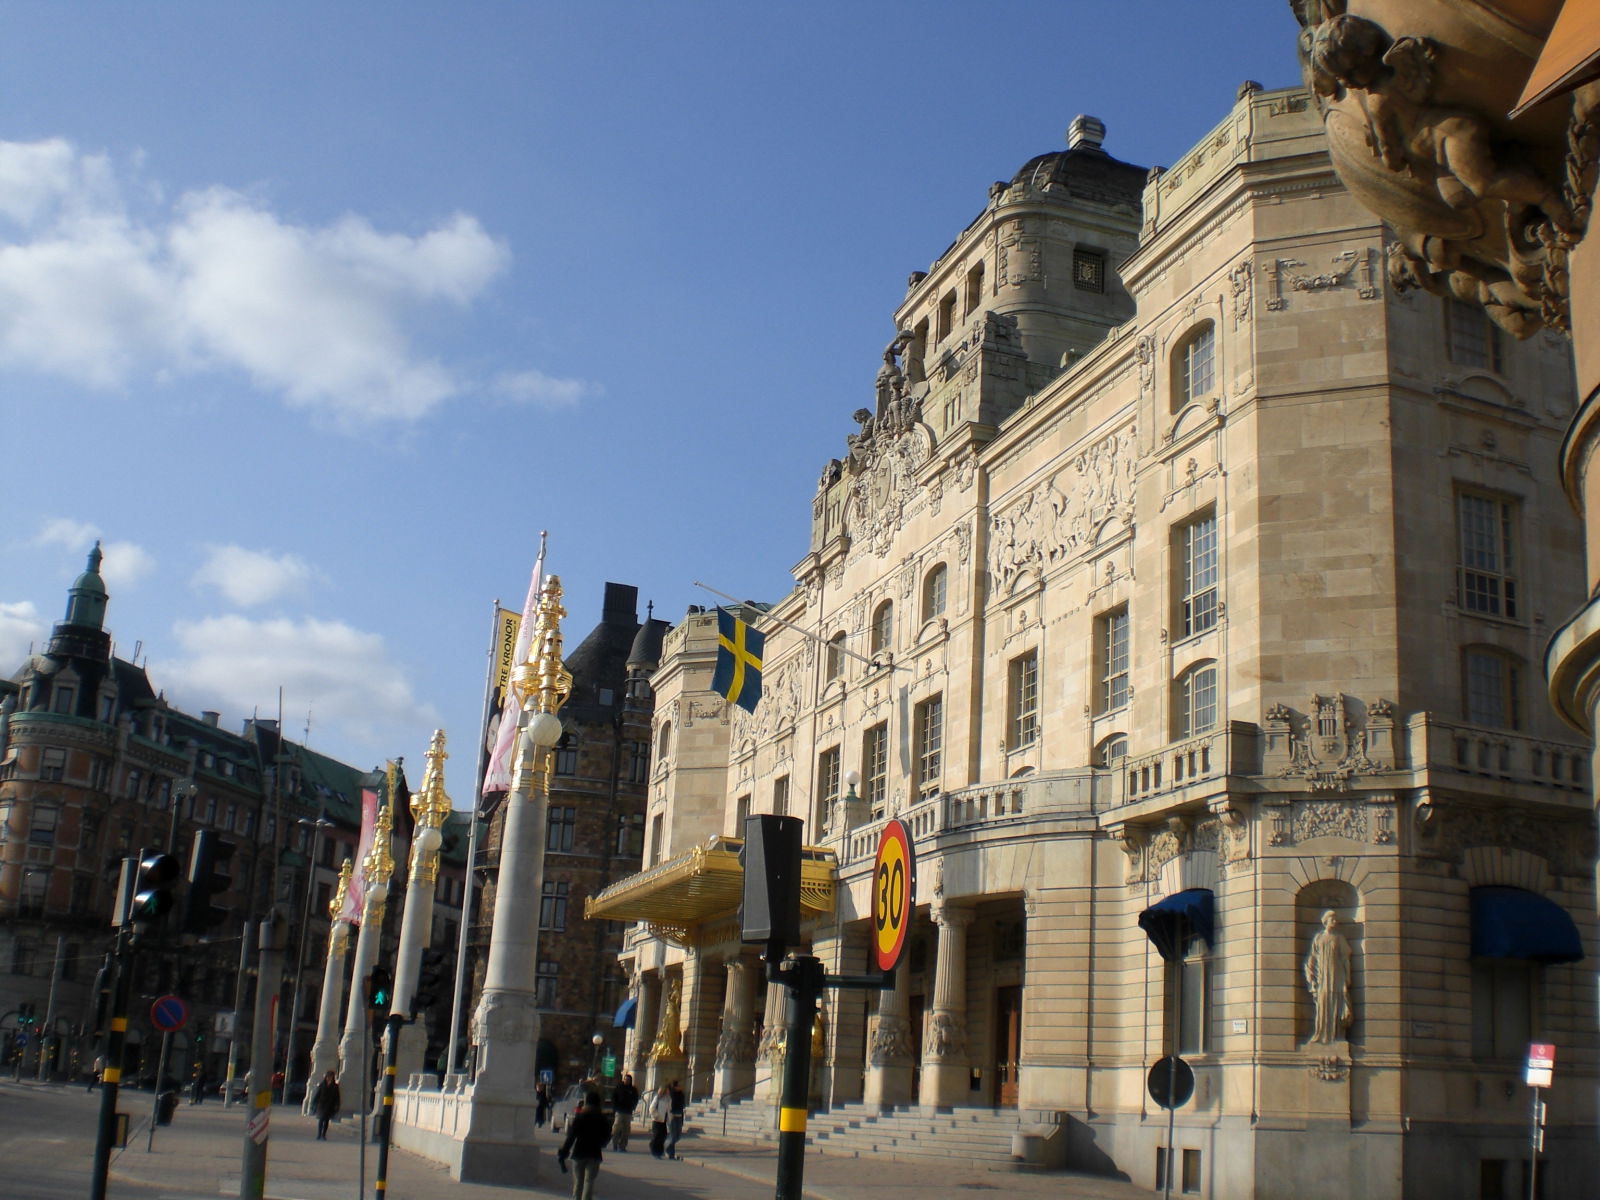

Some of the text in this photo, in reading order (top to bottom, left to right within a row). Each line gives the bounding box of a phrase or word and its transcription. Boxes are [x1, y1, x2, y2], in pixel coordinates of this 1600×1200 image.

[500, 618, 513, 688] TRE KRONOR
[877, 858, 904, 931] 30
